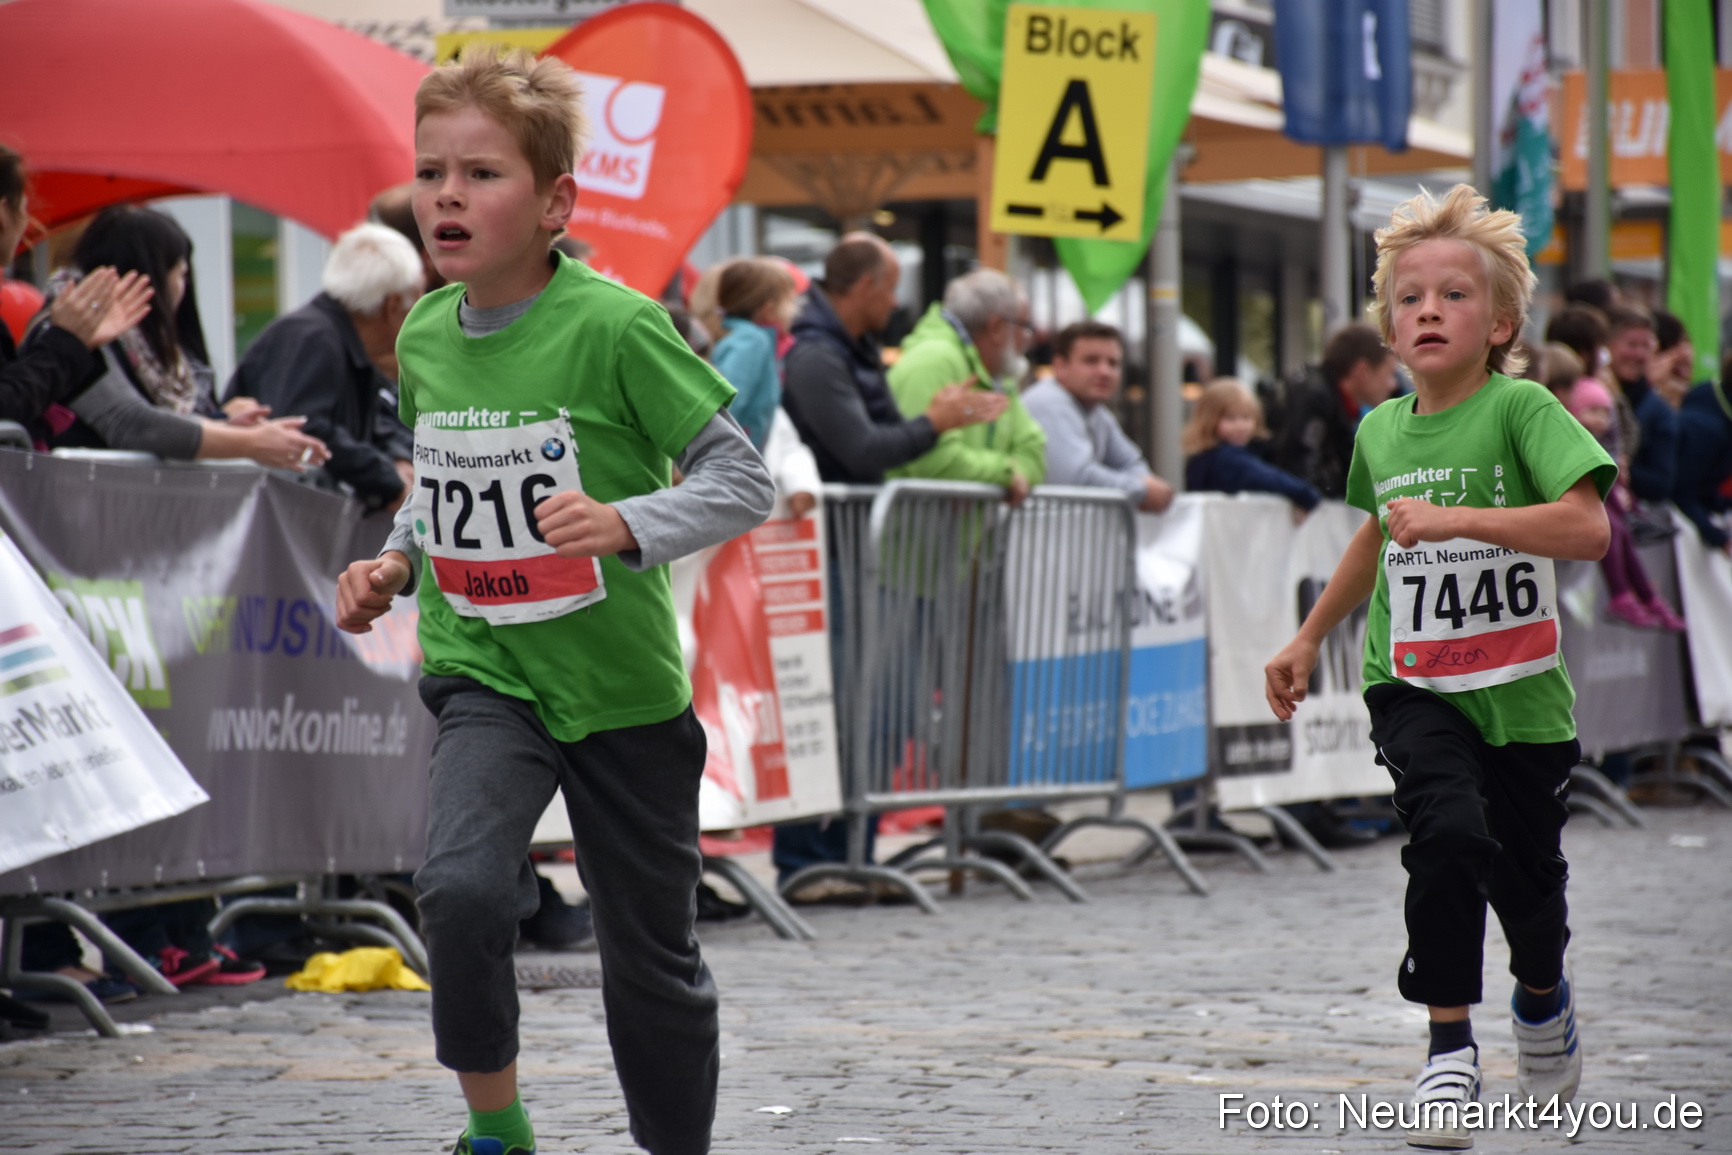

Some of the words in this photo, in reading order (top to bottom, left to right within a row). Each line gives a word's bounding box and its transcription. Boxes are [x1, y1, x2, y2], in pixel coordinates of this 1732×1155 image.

[1027, 14, 1139, 62] Block
[1028, 79, 1111, 188] A
[577, 150, 639, 186] KMS
[415, 443, 444, 467] PARTL
[445, 448, 534, 468] Neumarkt
[1374, 467, 1453, 498] Neumarkter
[420, 473, 557, 549] 7216
[1388, 552, 1433, 567] PARTL
[464, 569, 529, 597] Jakob
[1402, 561, 1539, 631] 7446
[1426, 645, 1489, 668] Leon
